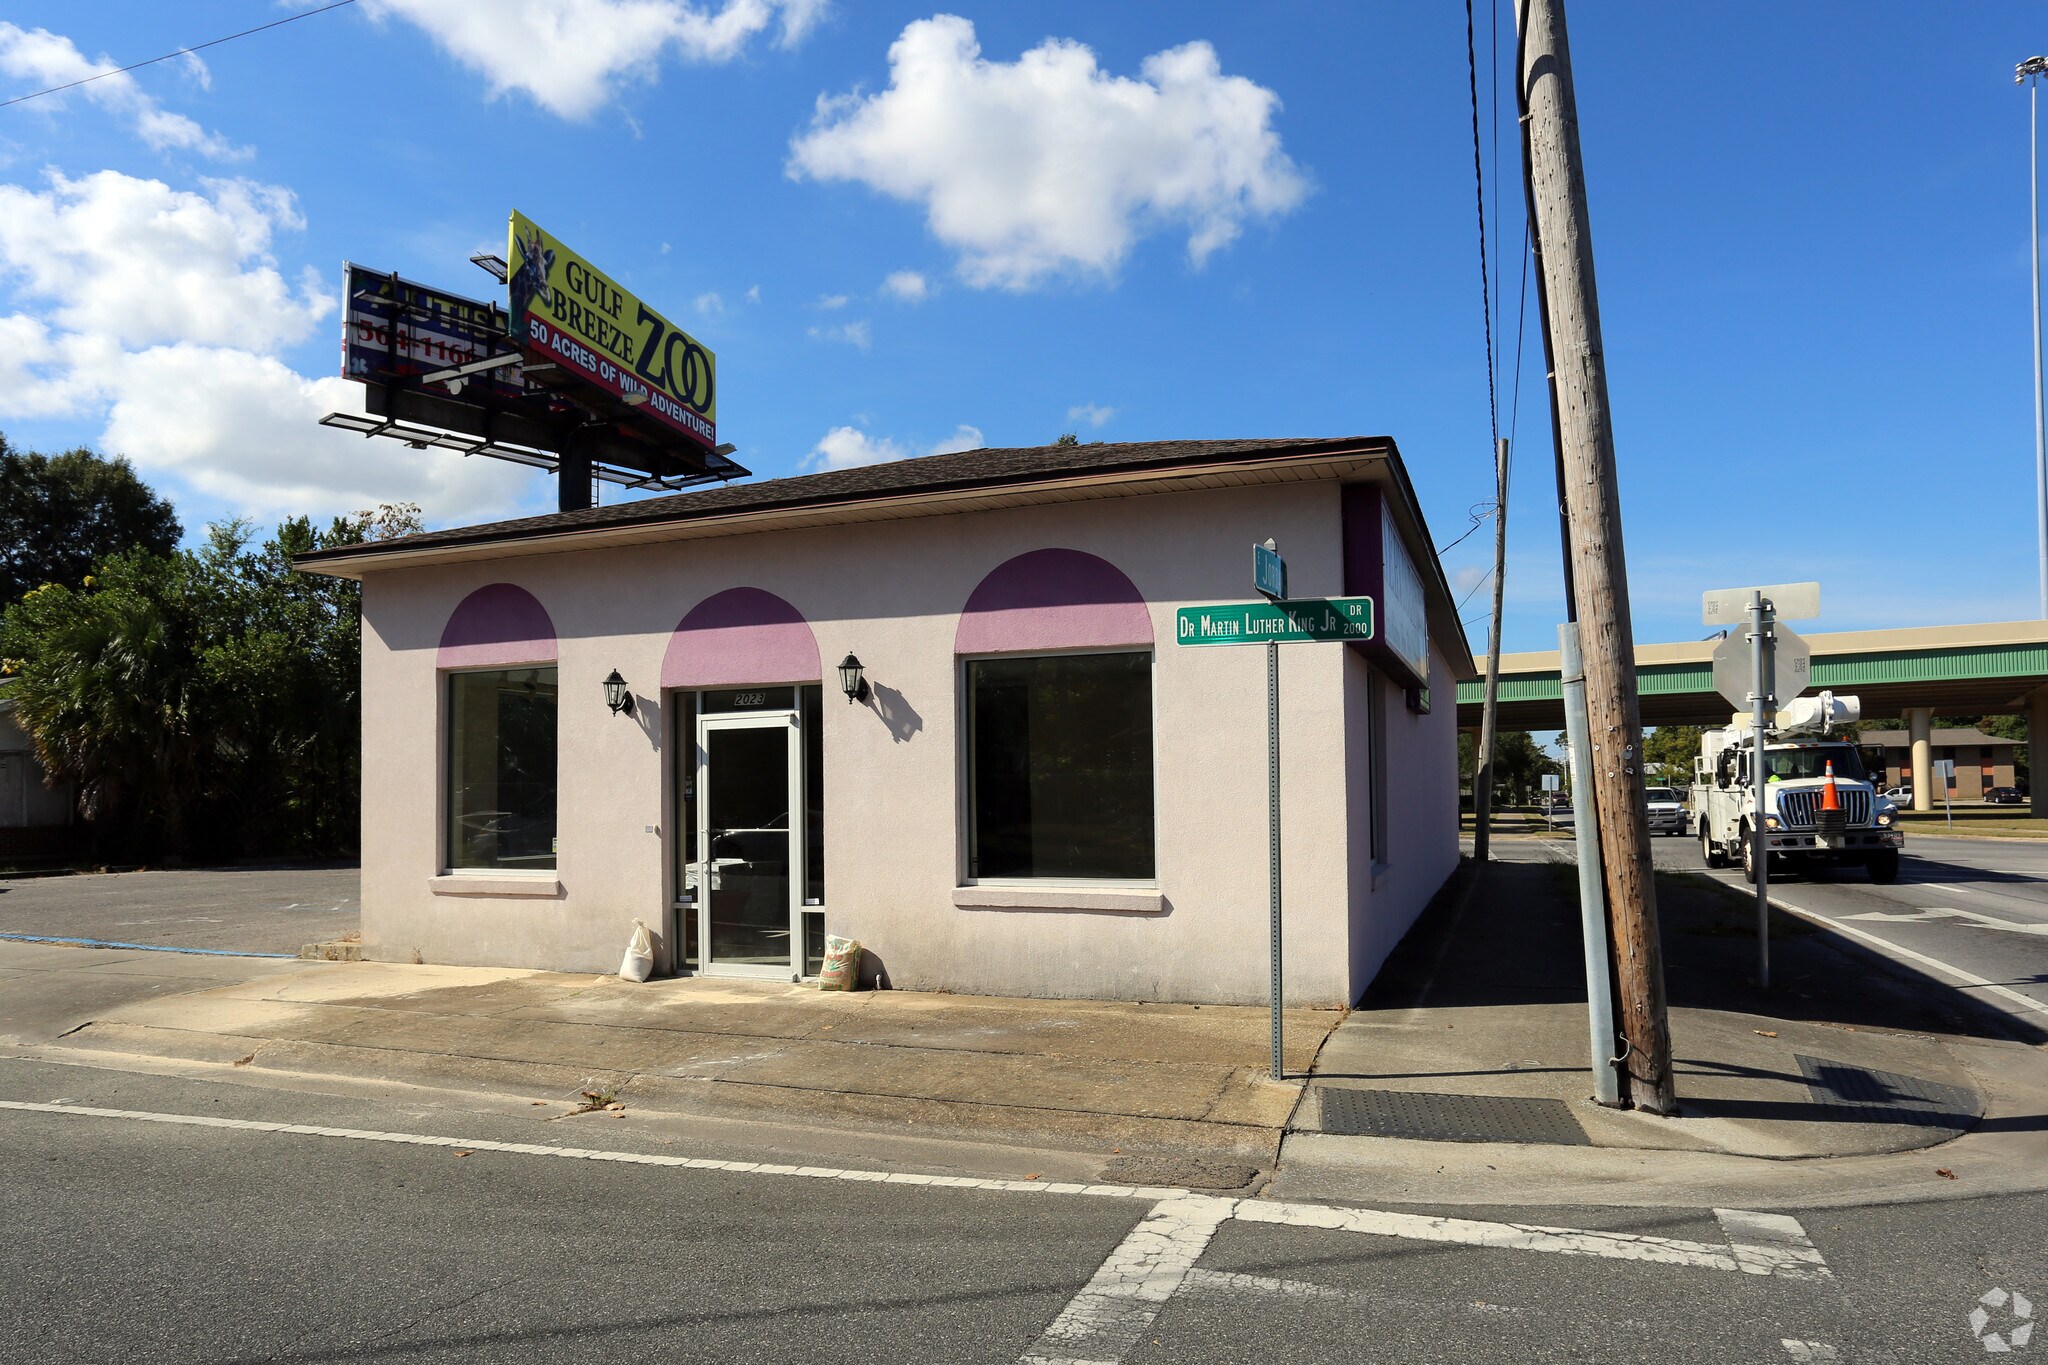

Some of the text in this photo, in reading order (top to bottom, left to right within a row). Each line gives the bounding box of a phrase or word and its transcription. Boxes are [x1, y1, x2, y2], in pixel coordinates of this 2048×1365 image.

[566, 261, 622, 320] GULF
[552, 287, 634, 365] BREEZE
[530, 318, 548, 344] 50
[551, 333, 597, 373] ACRES
[600, 361, 616, 382] OF
[650, 391, 714, 441] ADVENTURE!
[635, 302, 713, 413] ZOO
[1343, 622, 1367, 635] 2000
[1350, 605, 1362, 616] DR
[735, 694, 765, 705] 2023
